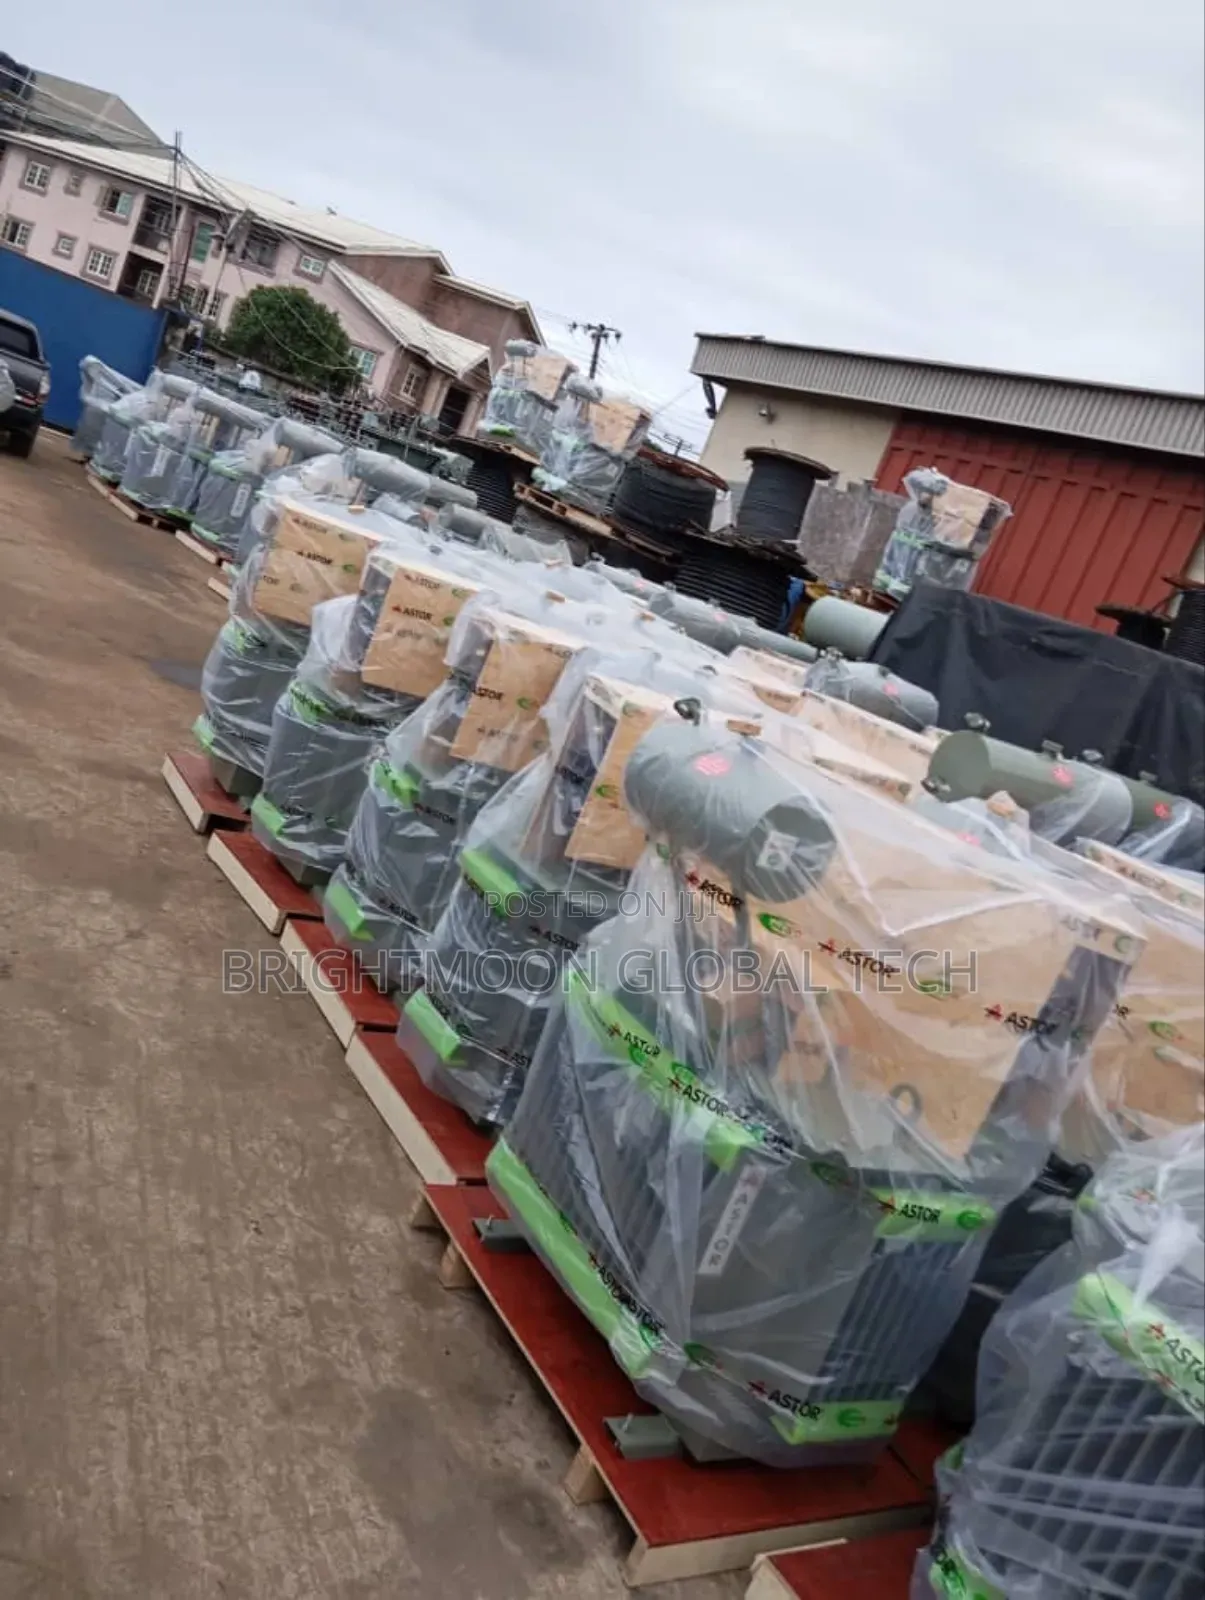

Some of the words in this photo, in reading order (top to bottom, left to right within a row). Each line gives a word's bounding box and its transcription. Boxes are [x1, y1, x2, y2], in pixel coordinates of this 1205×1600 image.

[401, 608, 432, 622] ASTOR
[541, 930, 581, 950] ASTOR
[838, 948, 900, 979] ASTOR
[623, 1032, 661, 1057] ASTOR
[683, 1084, 730, 1117] ASTOR
[900, 1203, 941, 1224] ASTOR
[708, 1193, 749, 1268] ASTOR
[768, 1389, 821, 1421] ASTOR
